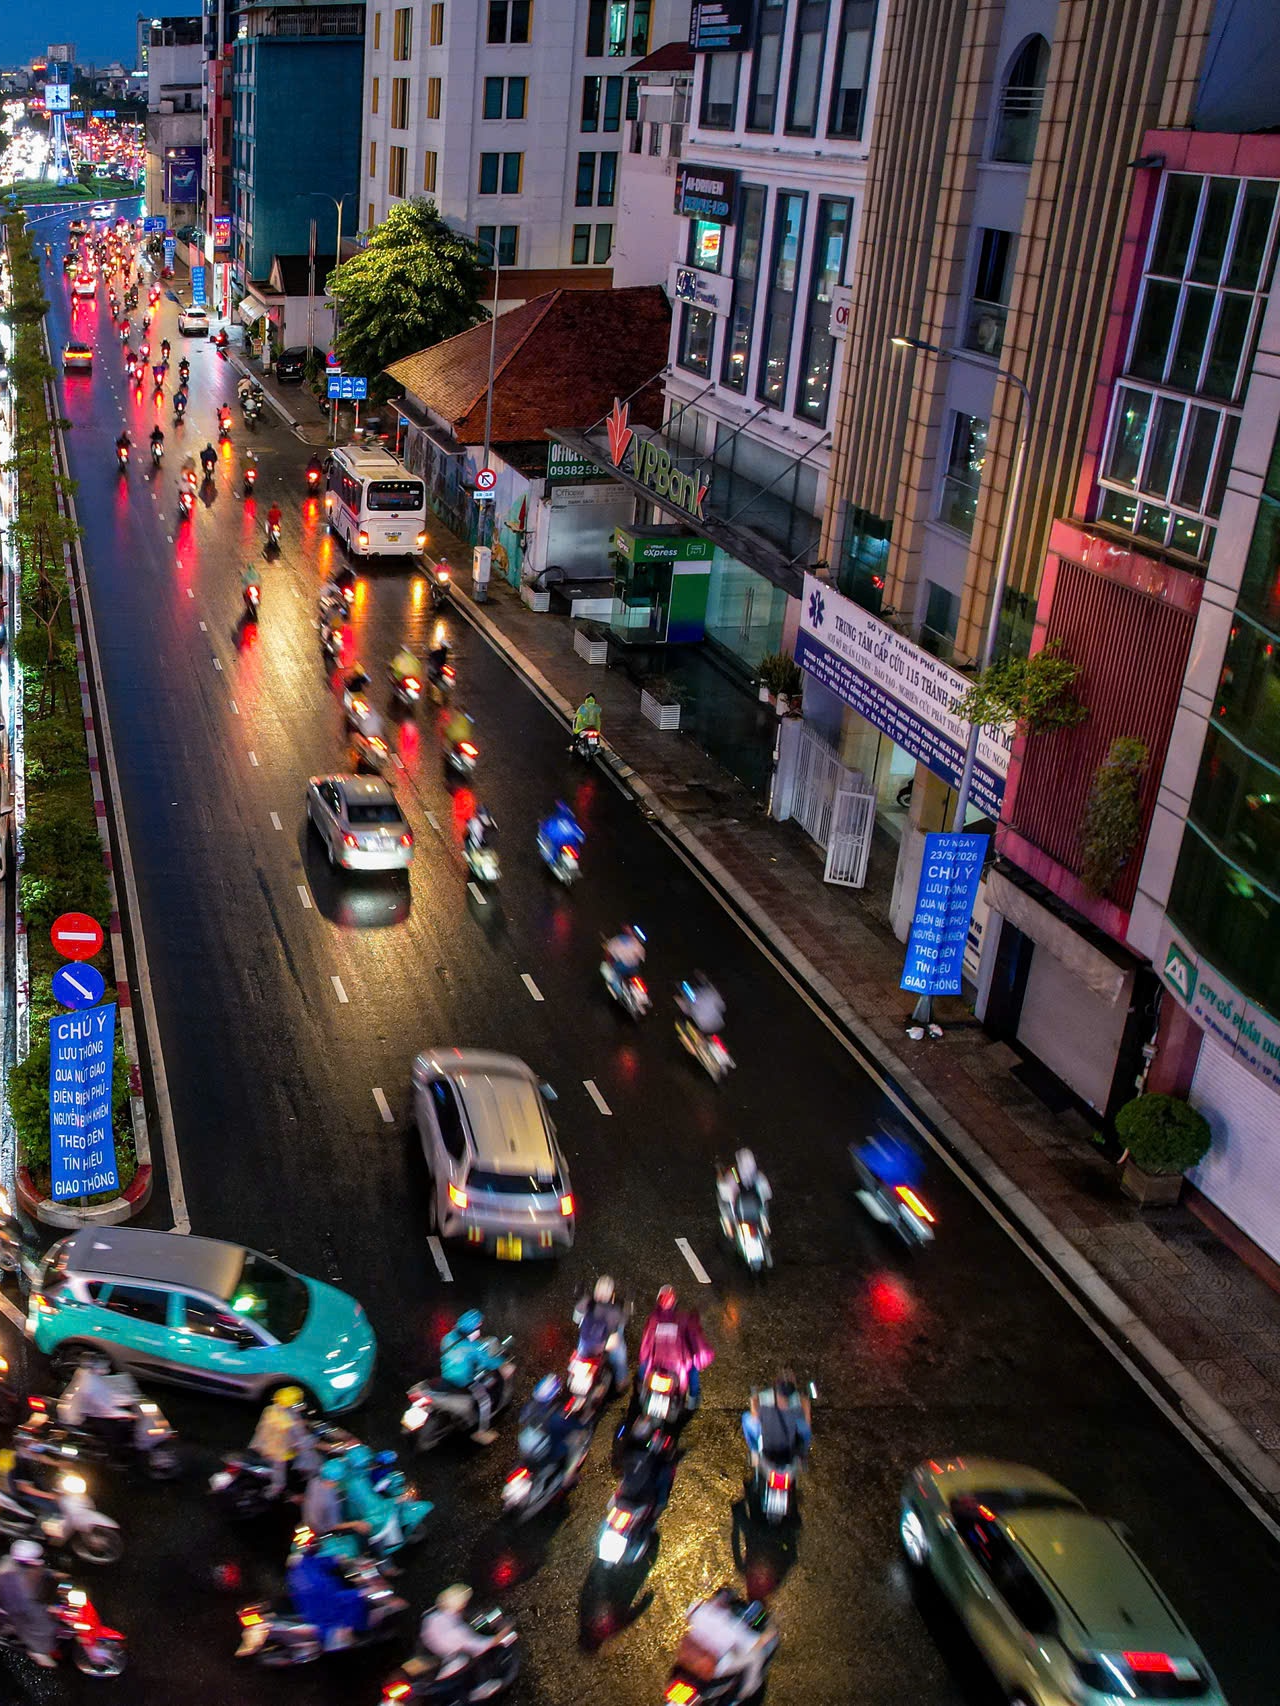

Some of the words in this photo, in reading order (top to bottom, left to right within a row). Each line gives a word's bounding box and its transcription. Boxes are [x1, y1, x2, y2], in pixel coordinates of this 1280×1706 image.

[632, 433, 708, 522] VPBank
[834, 614, 857, 643] TRUNG
[856, 626, 874, 654] TÂM
[872, 634, 889, 665] CẤP
[888, 648, 905, 677] CỨU
[905, 664, 920, 688] 115
[920, 670, 949, 708] THÀNH
[876, 626, 882, 637] Y
[936, 665, 948, 682] HỒ
[948, 673, 964, 693] CHÍ
[930, 850, 978, 861] 23/5/2026
[964, 864, 974, 879] Ý
[920, 898, 936, 909] QUA
[951, 900, 967, 910] GIAO
[914, 944, 939, 960] THEO
[915, 960, 930, 974] TÍN
[904, 975, 927, 990] GIAO
[58, 1015, 92, 1040] CHÚ
[97, 1011, 107, 1032] Ý
[58, 1046, 77, 1060] LƯU
[78, 1040, 103, 1061] THÔNG
[55, 1069, 73, 1082] QUA
[75, 1066, 88, 1084] NÚT
[89, 1061, 106, 1079] GIAO
[53, 1088, 74, 1107] ĐIỆN
[75, 1089, 91, 1105] BIÊN
[53, 1108, 79, 1128] NGUYỄN
[58, 1134, 86, 1150] THEO
[87, 1127, 105, 1147] ĐÈN
[62, 1153, 80, 1170] TÍN
[82, 1150, 103, 1171] HIỆU
[55, 1179, 79, 1196] GIAO
[81, 1171, 115, 1192] THÔNG
